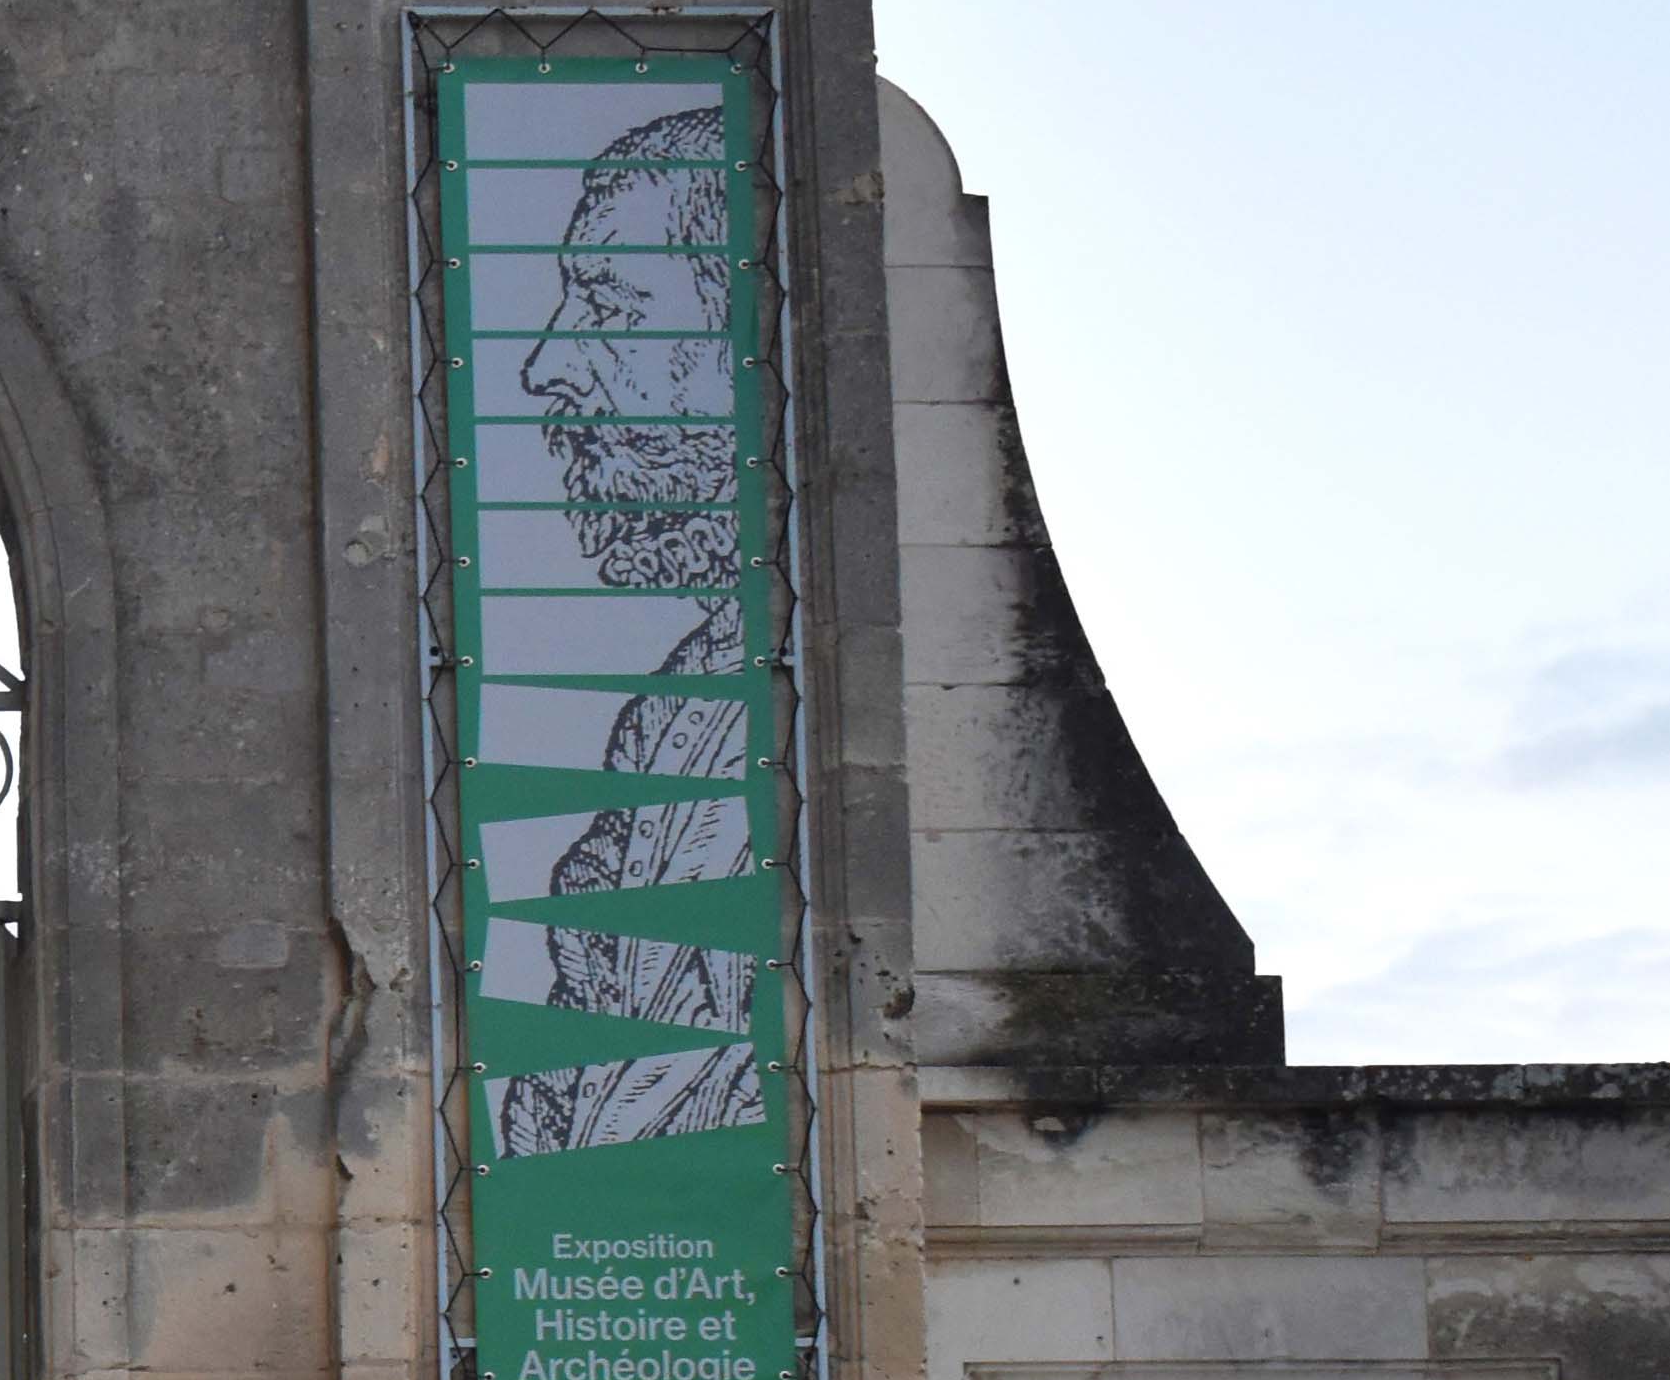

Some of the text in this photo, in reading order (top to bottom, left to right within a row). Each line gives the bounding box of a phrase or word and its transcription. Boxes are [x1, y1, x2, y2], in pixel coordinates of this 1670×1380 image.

[551, 1233, 714, 1264] Exposition
[513, 1266, 644, 1301] Musée
[534, 1308, 737, 1342] Histoire et
